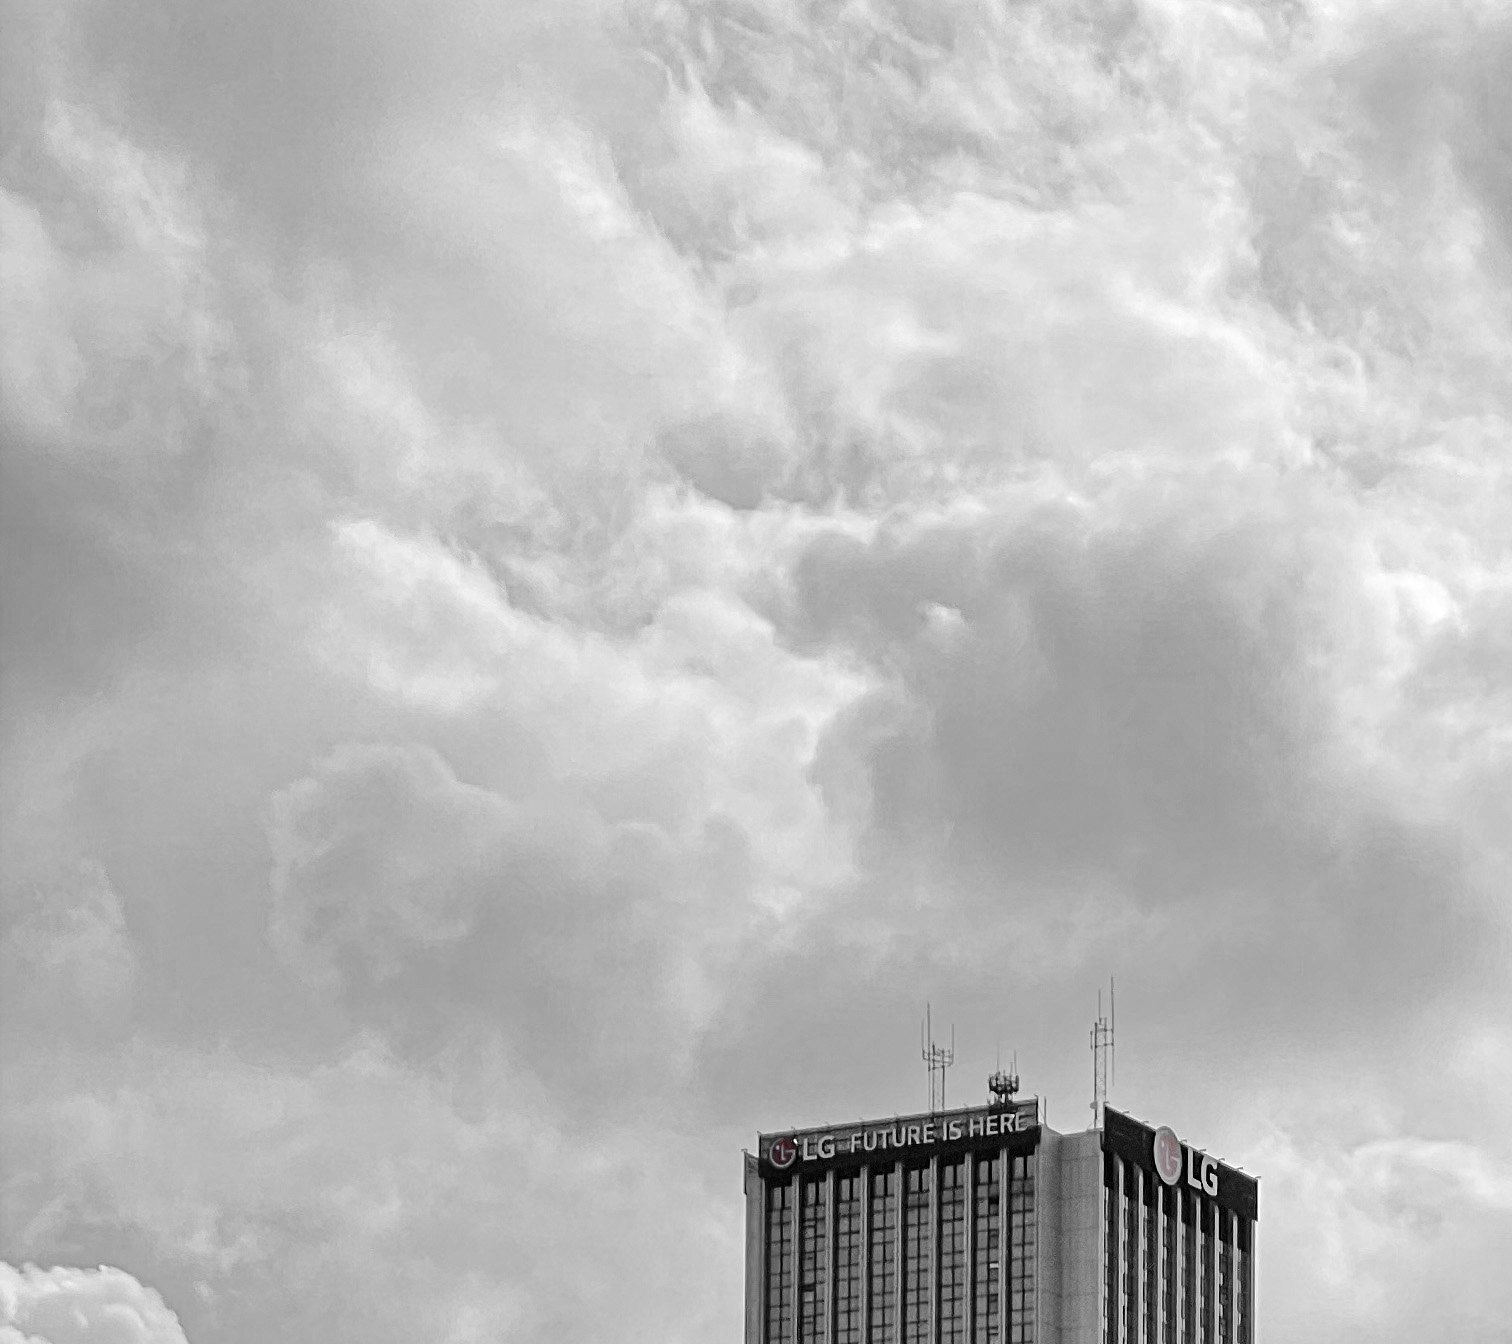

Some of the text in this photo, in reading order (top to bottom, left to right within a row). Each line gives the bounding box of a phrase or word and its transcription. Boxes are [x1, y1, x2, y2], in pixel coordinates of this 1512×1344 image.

[801, 1111, 1029, 1161] LG FUTURE IS HERE
[1187, 1147, 1218, 1197] LG
